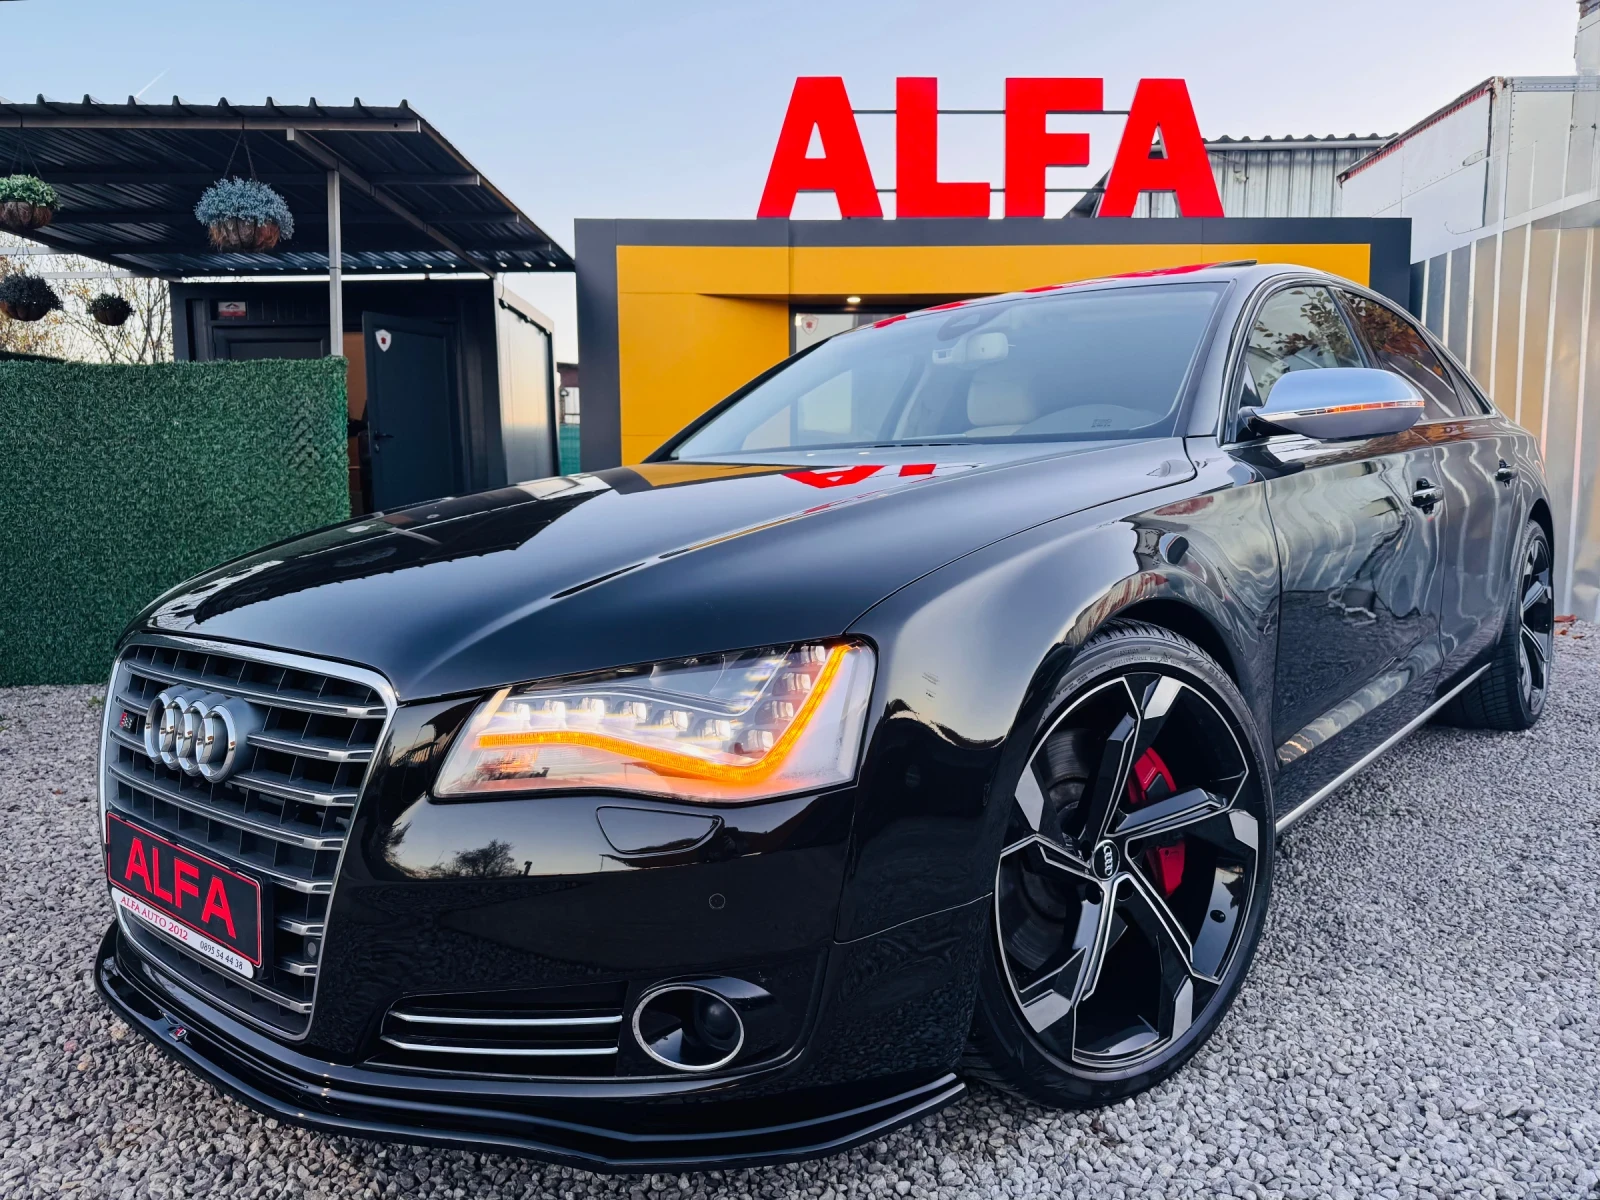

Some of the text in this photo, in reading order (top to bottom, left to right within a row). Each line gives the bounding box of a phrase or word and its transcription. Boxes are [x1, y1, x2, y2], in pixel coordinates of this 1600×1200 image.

[757, 76, 1225, 218] ALFA
[121, 896, 188, 941] ALFA AUTO 2012
[125, 837, 236, 939] ALFA
[200, 940, 243, 970] 0895 54 44 38
